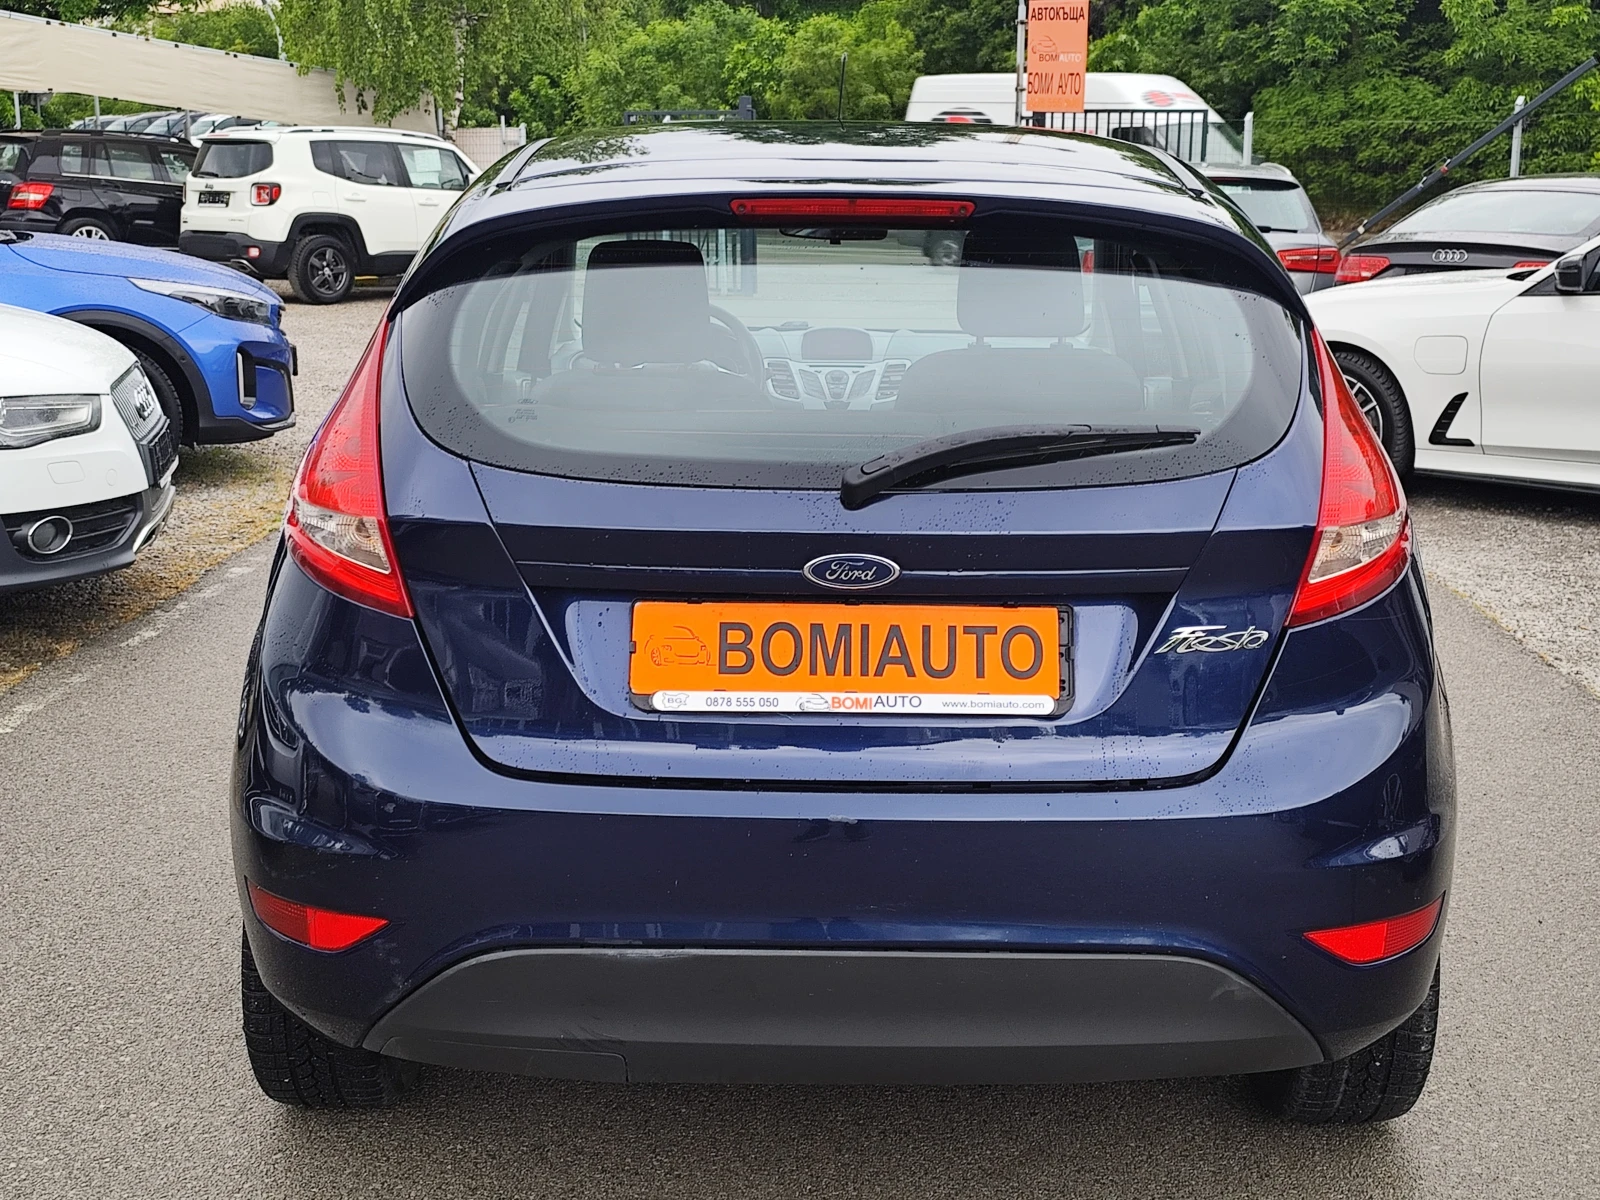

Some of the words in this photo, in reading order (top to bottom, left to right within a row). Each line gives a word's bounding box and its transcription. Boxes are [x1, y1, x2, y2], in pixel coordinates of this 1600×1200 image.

[1030, 6, 1085, 23] АВТОКЪЩА
[1027, 72, 1054, 95] БОМИ
[1057, 72, 1082, 95] АУТО
[825, 560, 877, 580] Ford
[1154, 625, 1269, 654] Fiesta
[717, 621, 1045, 681] BOMIAUTO
[705, 696, 732, 707] 0878
[736, 697, 755, 708] 555
[759, 697, 779, 708] 050
[942, 699, 1045, 709] www.bomiauto.com
